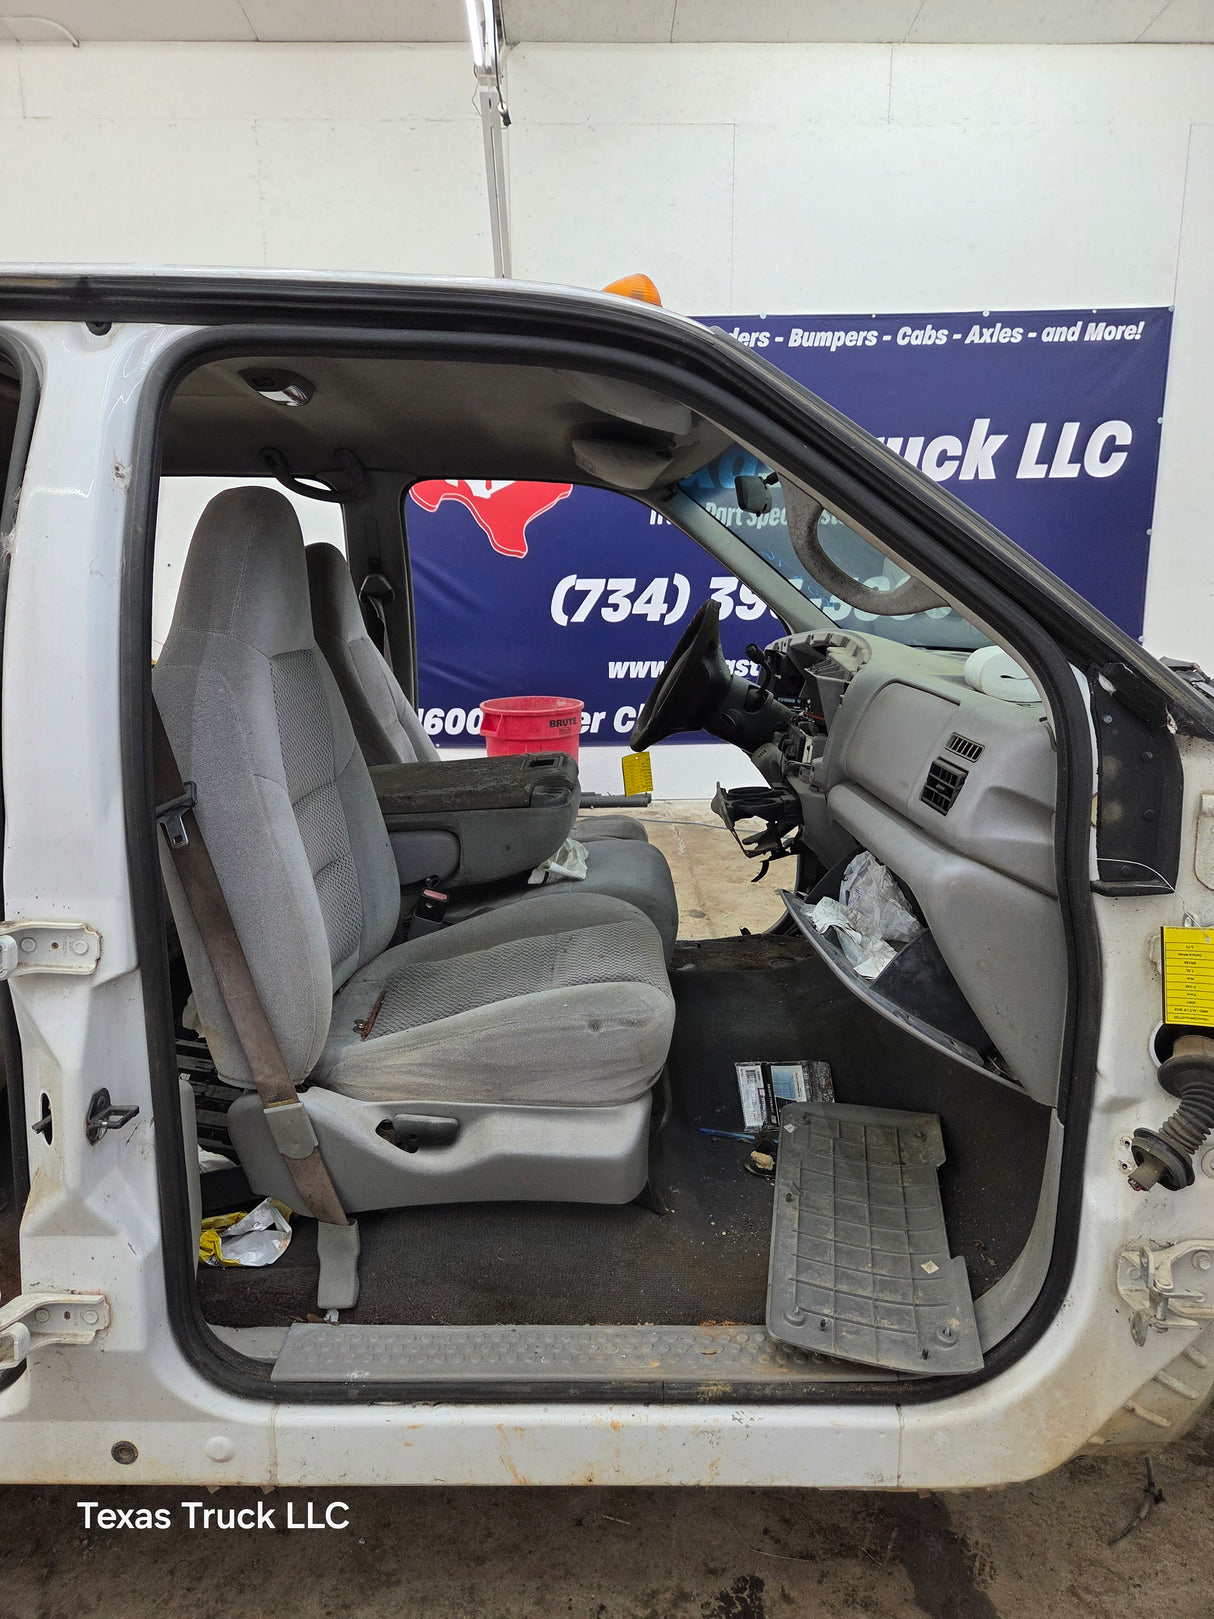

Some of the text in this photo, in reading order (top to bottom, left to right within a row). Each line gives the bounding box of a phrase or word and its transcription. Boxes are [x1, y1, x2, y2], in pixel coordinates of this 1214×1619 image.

[728, 327, 770, 347] ders
[788, 328, 878, 351] Bumpers
[896, 324, 949, 345] Cabs
[964, 323, 1023, 344] Axles
[1041, 321, 1083, 342] and
[1084, 321, 1145, 341] More!
[875, 418, 1132, 482] uck LLC
[551, 573, 690, 627] (734)
[549, 717, 577, 728] BRUTE
